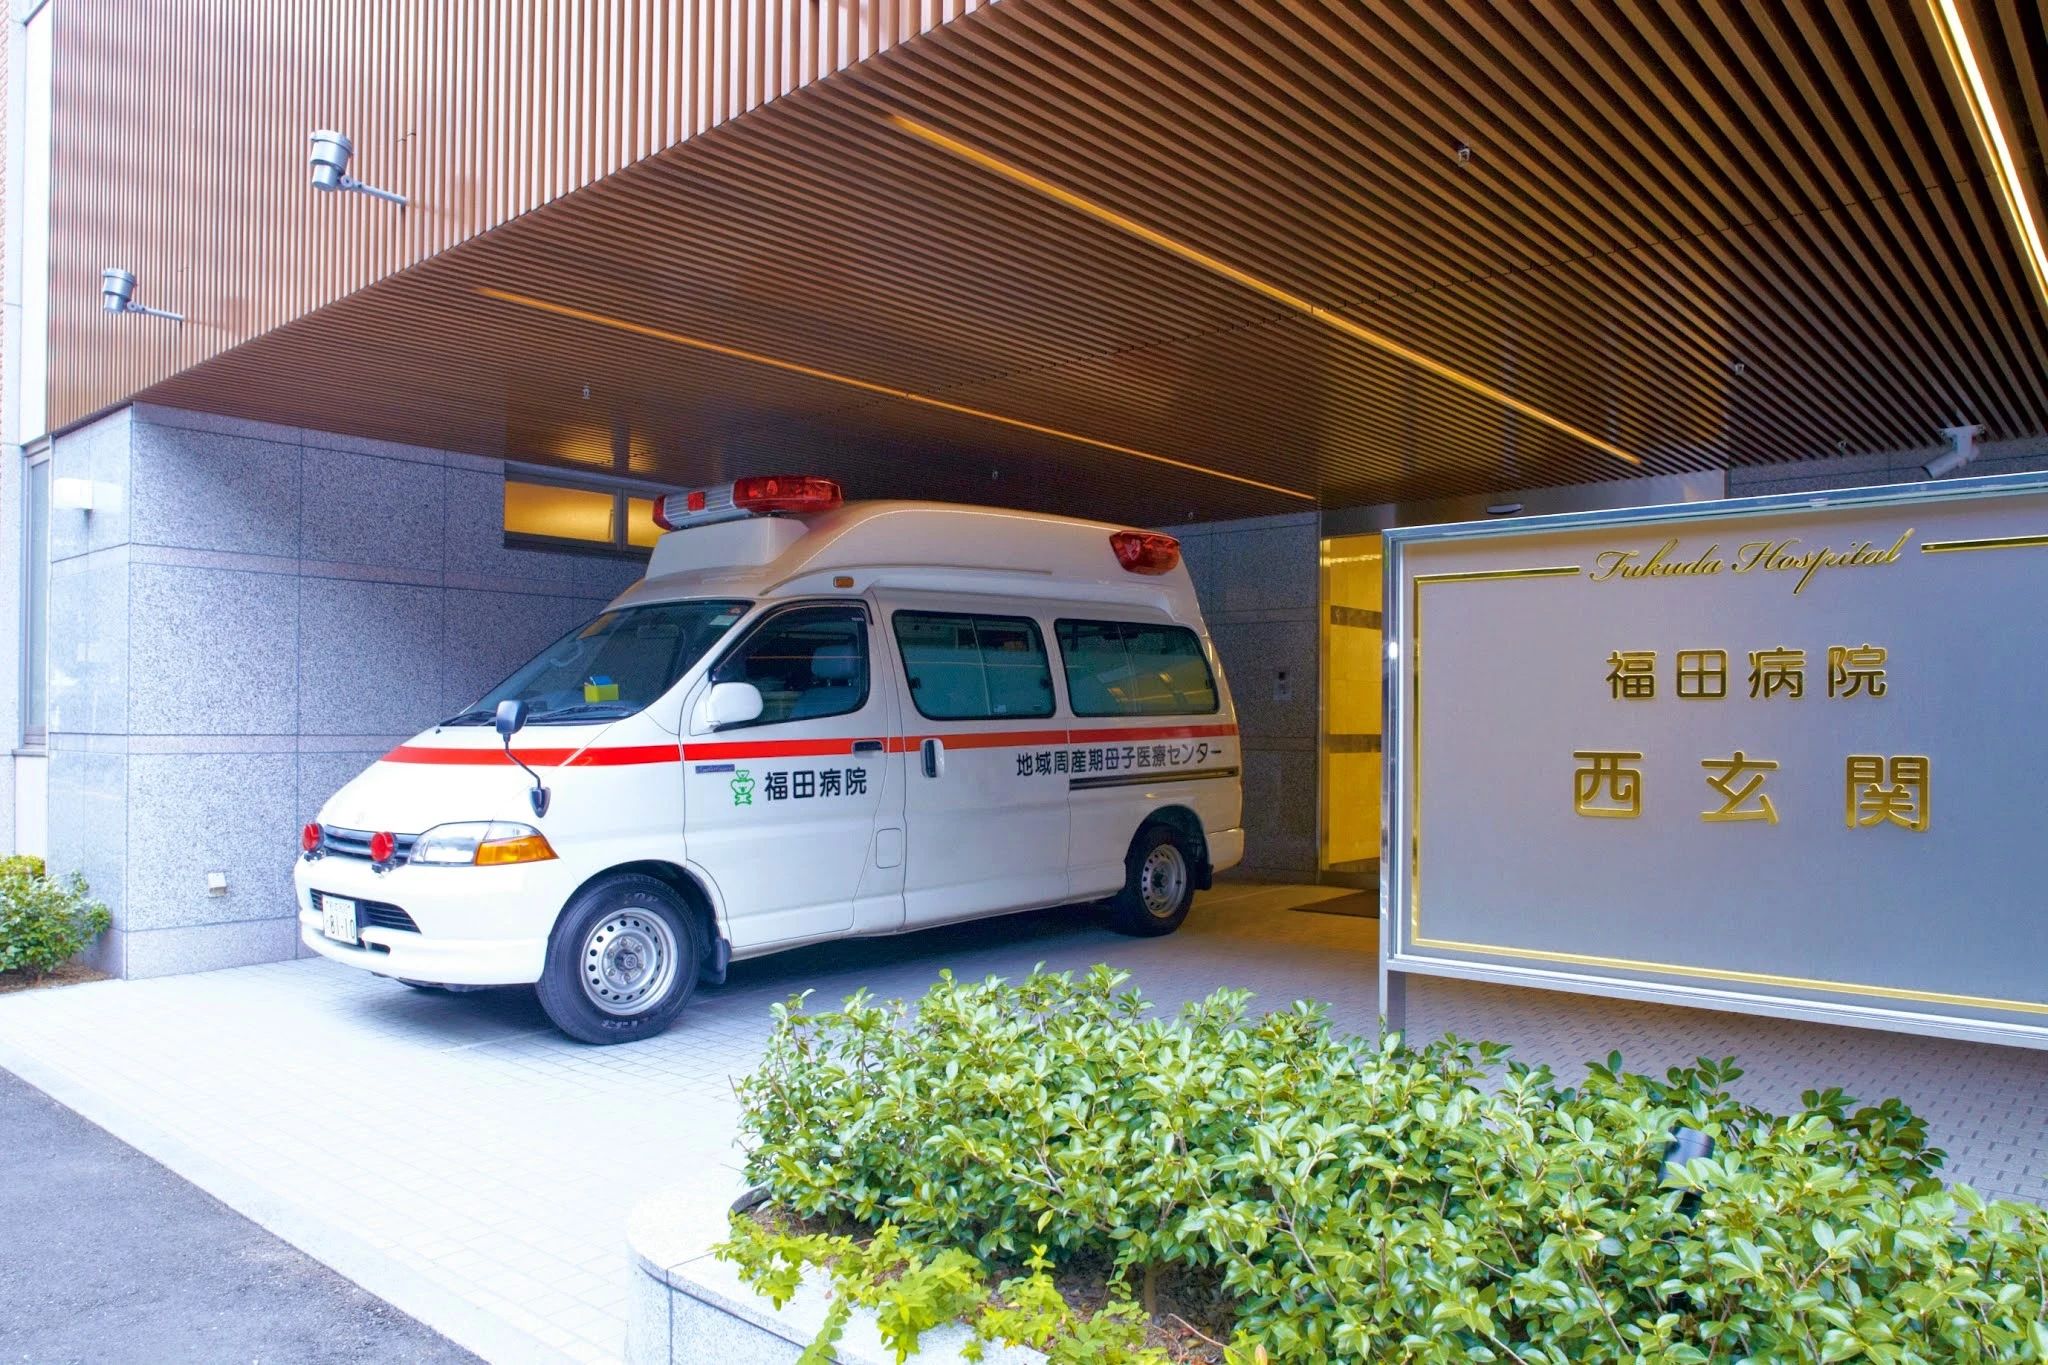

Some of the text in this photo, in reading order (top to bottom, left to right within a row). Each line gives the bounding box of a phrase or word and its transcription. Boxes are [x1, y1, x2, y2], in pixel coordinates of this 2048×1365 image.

[1590, 527, 1914, 595] Fukuda Hospital
[1605, 644, 1888, 700] 福田病院
[764, 767, 867, 801] 福田病院
[1016, 742, 1222, 777] 地域周産期母子医療センター
[1573, 751, 1931, 831] 西玄関
